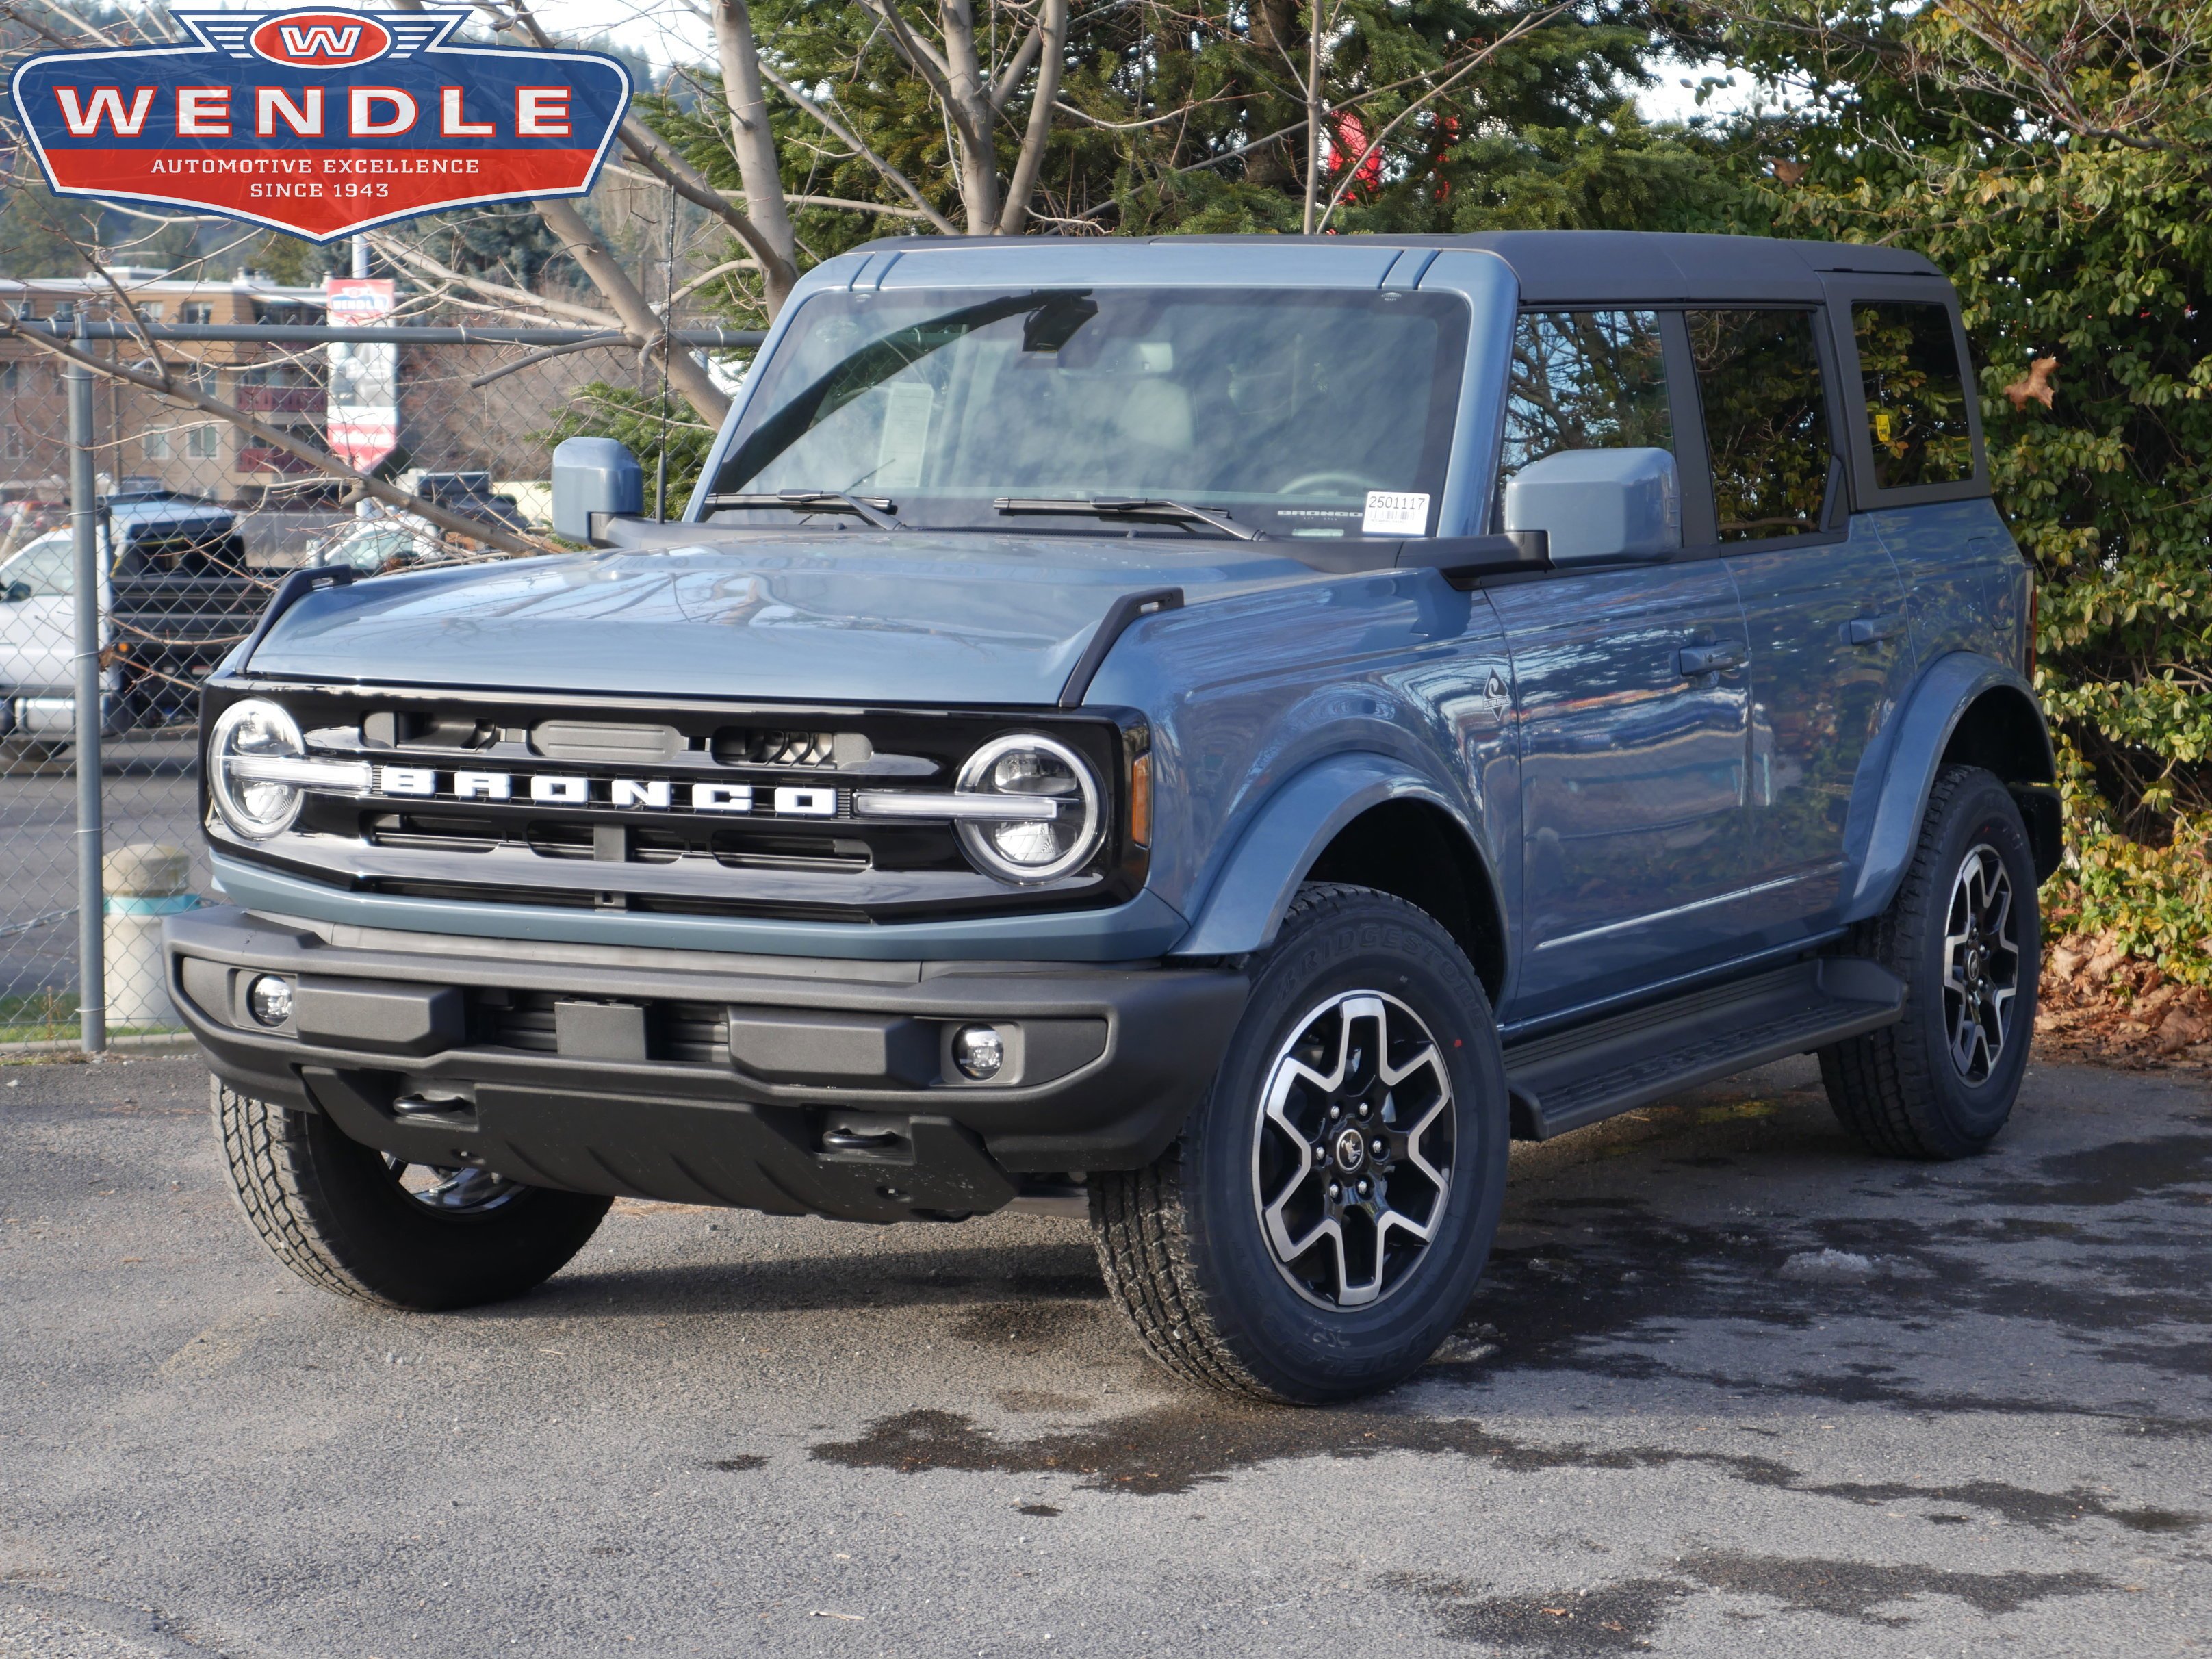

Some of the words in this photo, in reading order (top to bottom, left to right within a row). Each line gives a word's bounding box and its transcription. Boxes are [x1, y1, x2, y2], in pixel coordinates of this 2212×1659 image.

[1369, 496, 1425, 510] 2501117
[381, 767, 836, 815] BRONCO
[1273, 922, 1486, 1029] BRIDGESTONE
